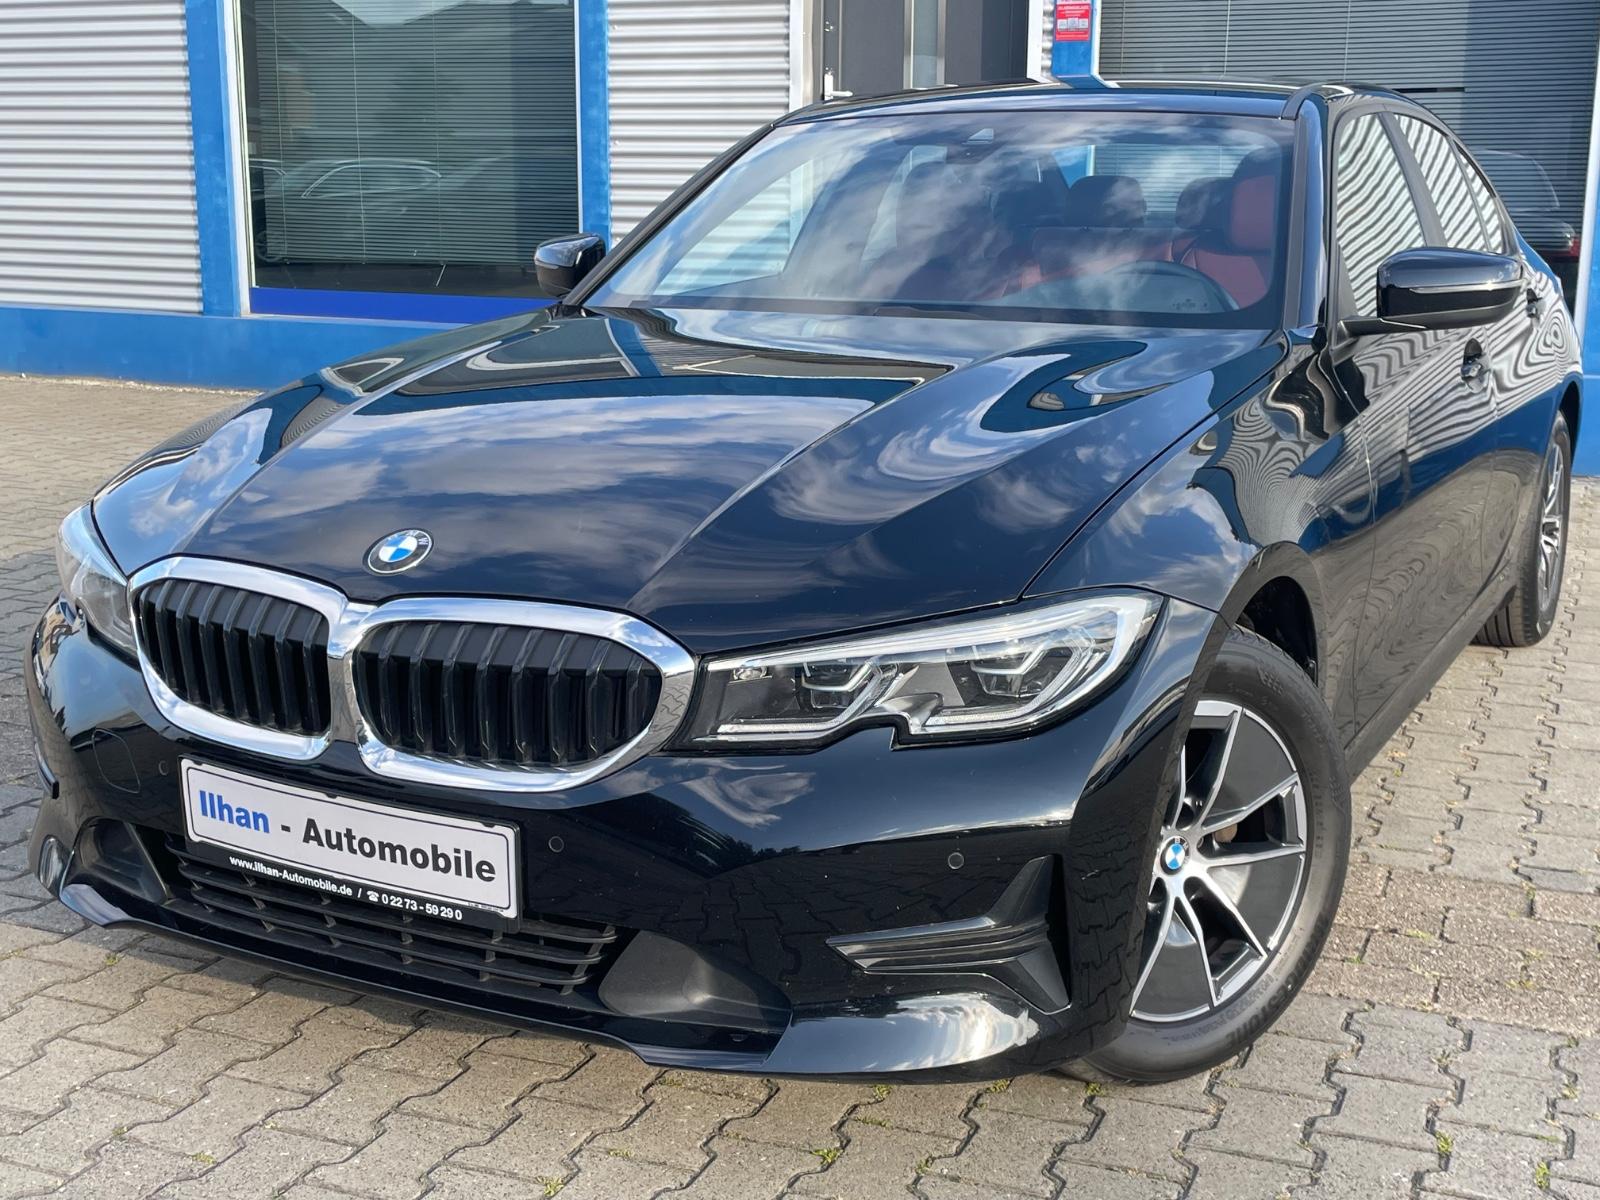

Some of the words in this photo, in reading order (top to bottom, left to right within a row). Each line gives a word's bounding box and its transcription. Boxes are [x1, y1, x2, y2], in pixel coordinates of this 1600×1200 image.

[199, 789, 270, 834] Ilhan
[280, 824, 291, 833] -
[302, 818, 496, 882] Automobile
[357, 887, 363, 898] /
